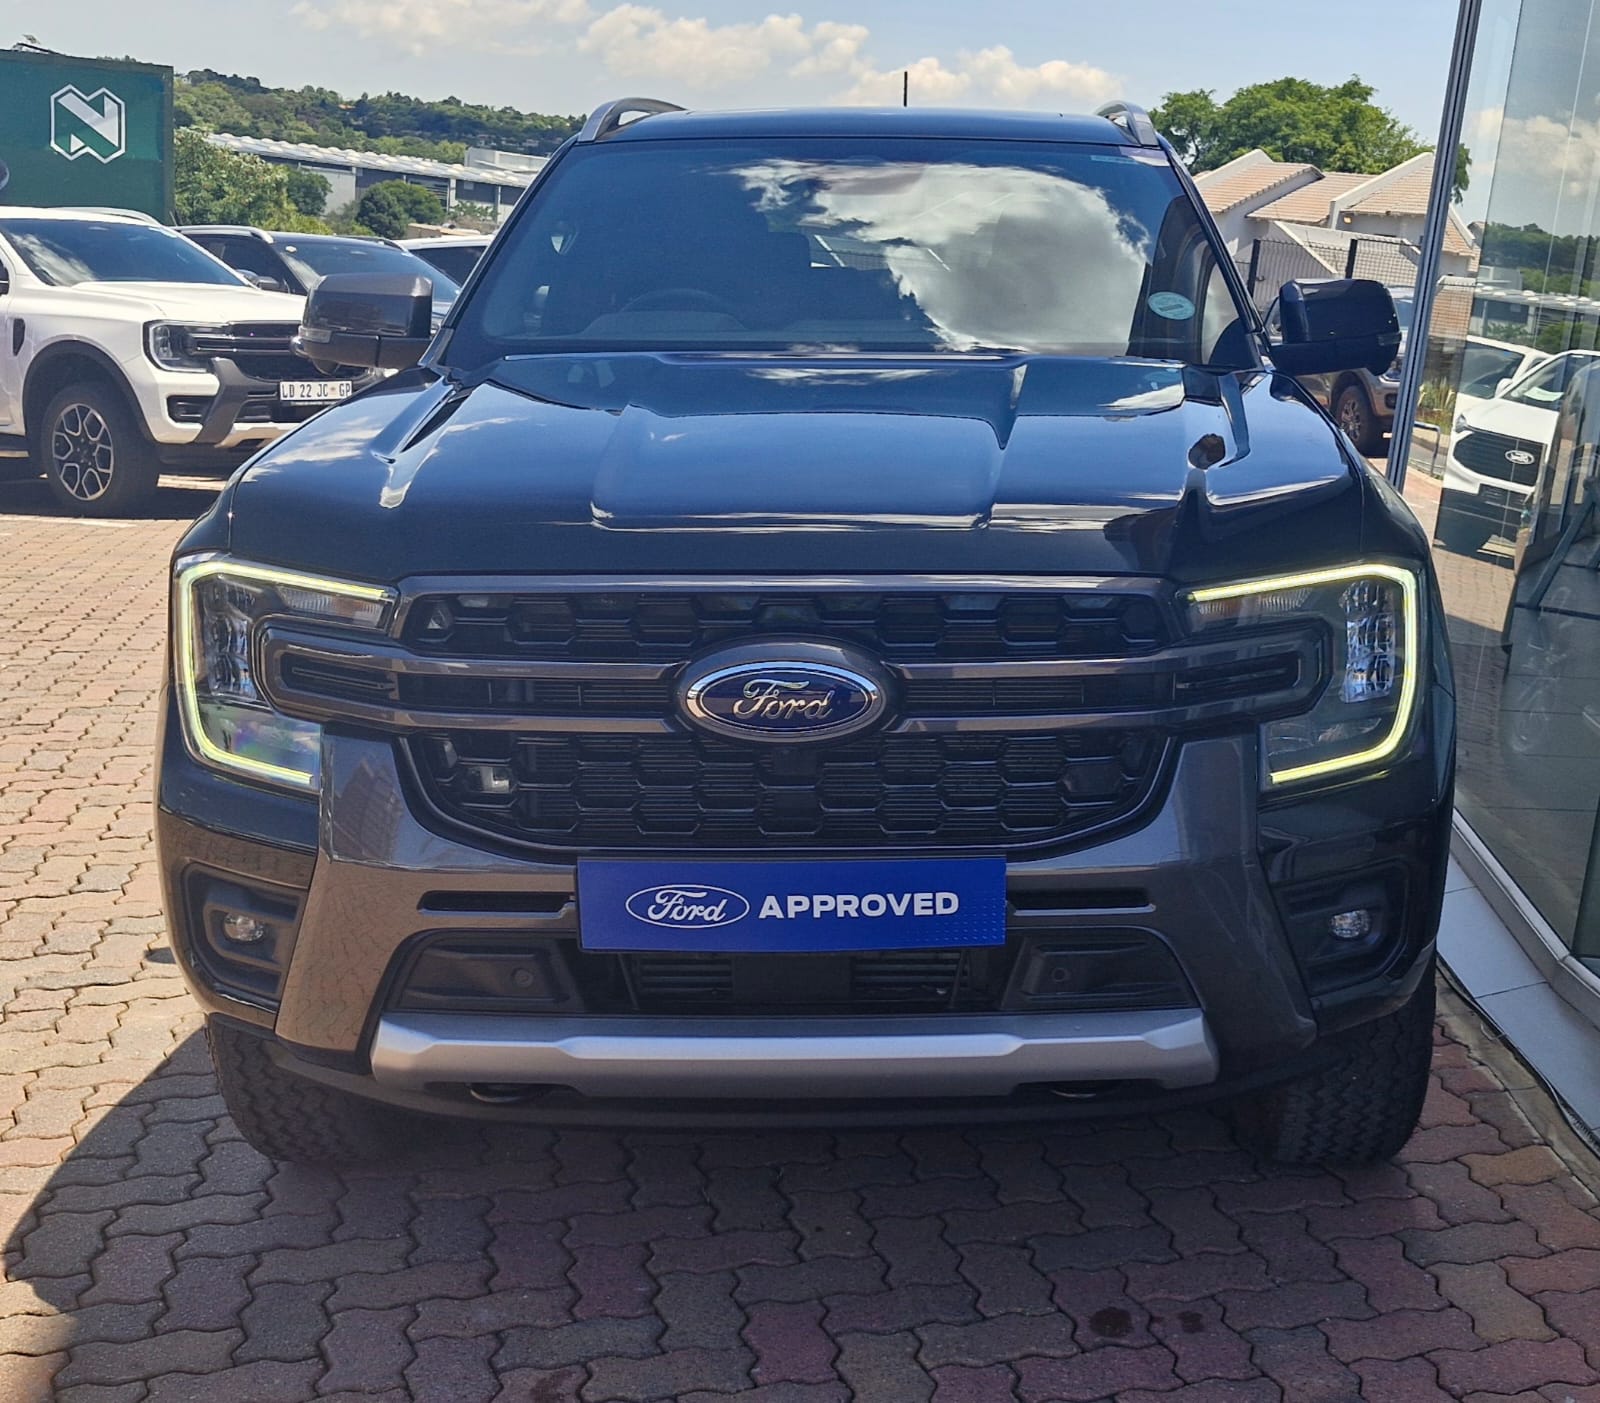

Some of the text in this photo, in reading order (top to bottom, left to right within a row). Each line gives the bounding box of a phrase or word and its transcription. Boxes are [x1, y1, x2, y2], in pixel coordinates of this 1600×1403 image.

[281, 383, 351, 399] LD 22 JC GP
[732, 678, 835, 720] Ford
[647, 888, 959, 922] Ford APPROVED
